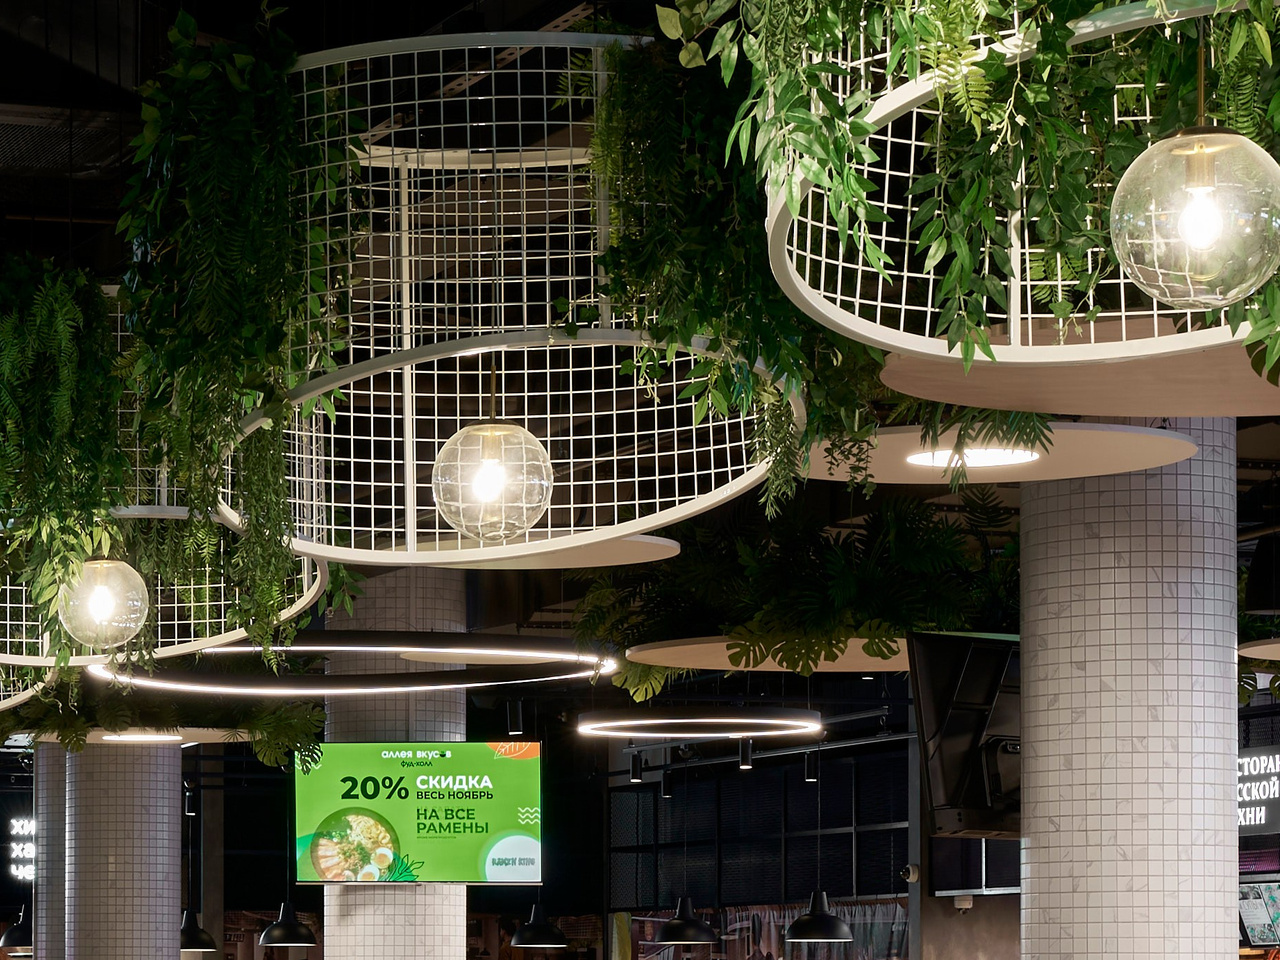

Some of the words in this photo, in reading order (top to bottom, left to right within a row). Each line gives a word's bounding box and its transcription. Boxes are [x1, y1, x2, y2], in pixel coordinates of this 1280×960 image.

[340, 776, 409, 800] 20%
[416, 775, 493, 791] СКИДКА
[416, 791, 445, 800] ВЕСЬ
[448, 791, 494, 800] НОЯБРЬ
[416, 808, 439, 820] НА
[444, 808, 476, 820] ВСЕ
[416, 822, 489, 834] РАМЕНЫ
